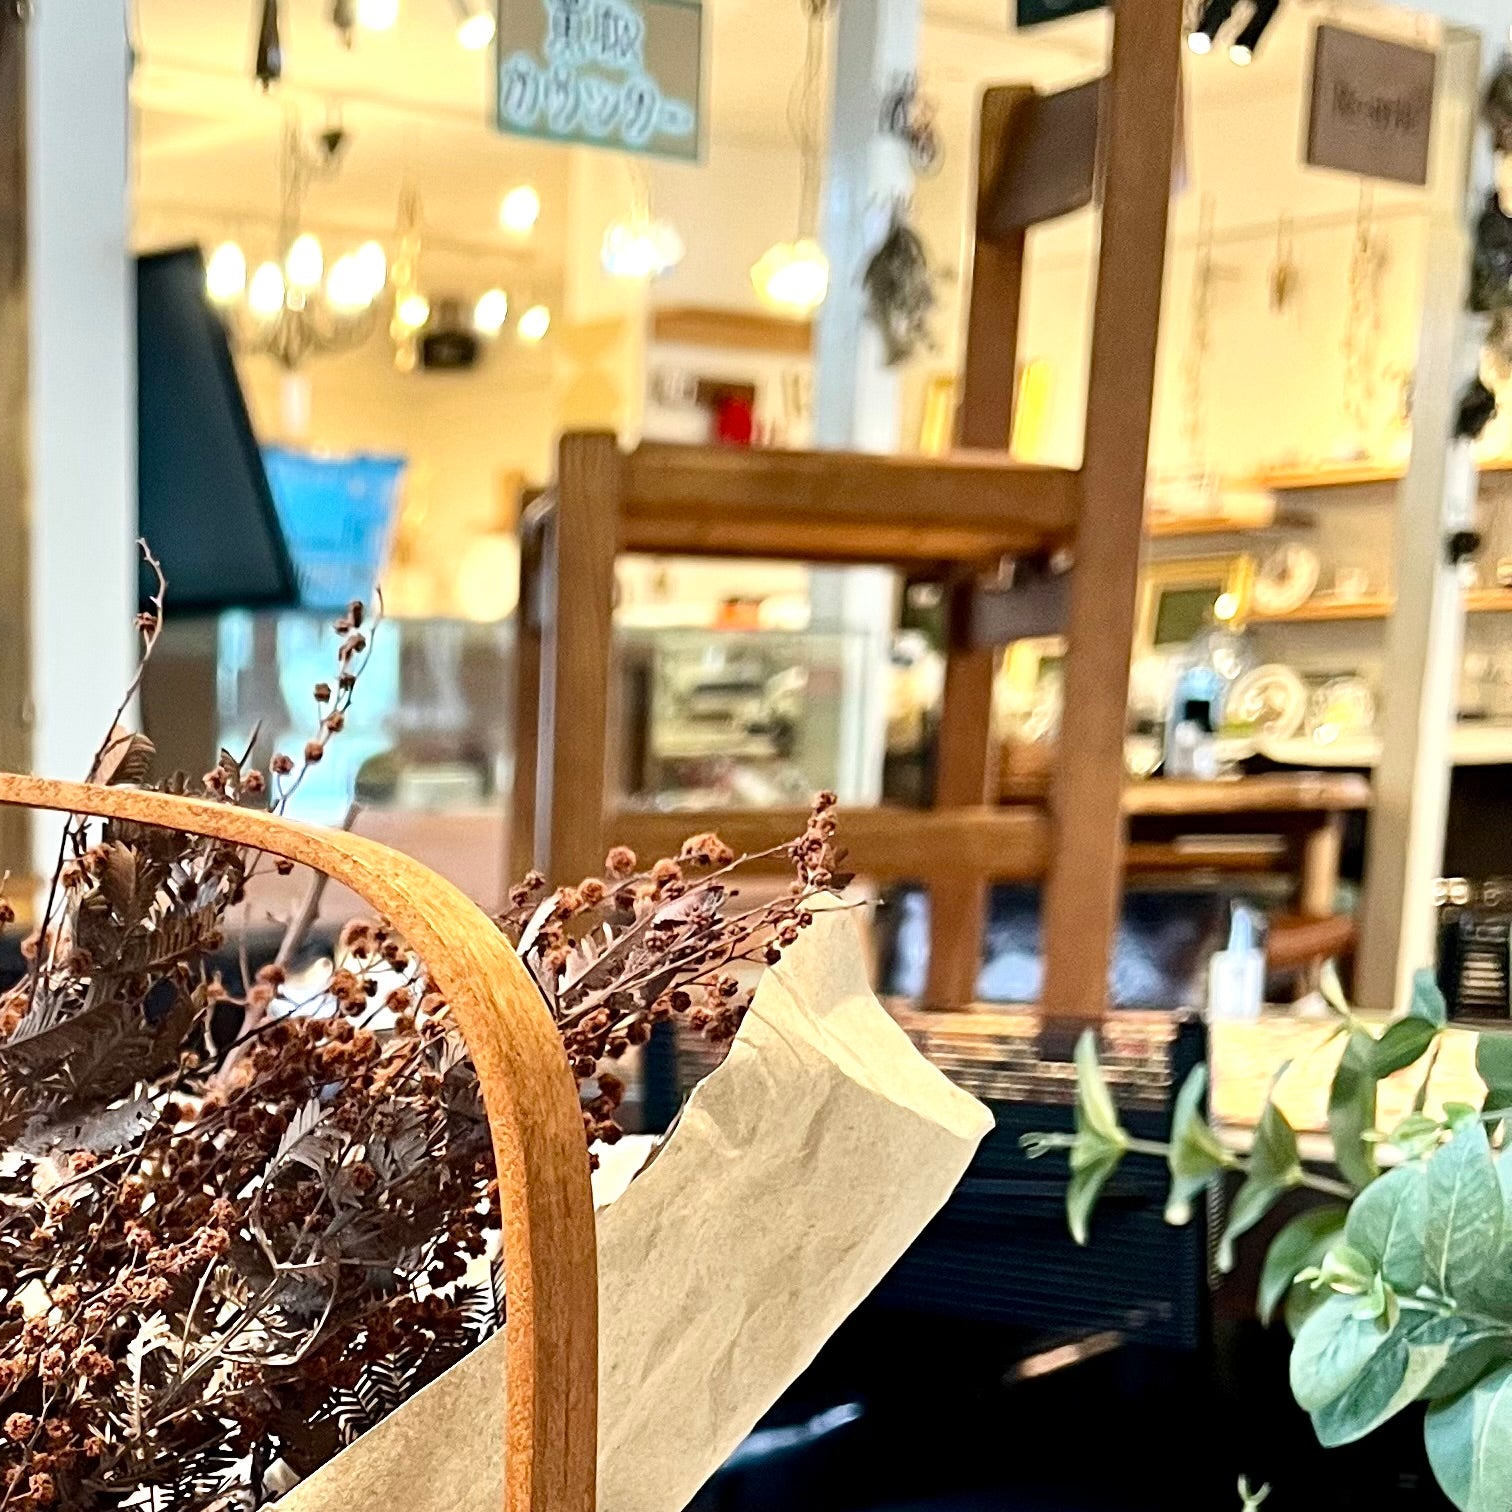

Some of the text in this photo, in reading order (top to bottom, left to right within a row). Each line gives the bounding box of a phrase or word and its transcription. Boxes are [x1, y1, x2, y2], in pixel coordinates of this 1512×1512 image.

[502, 54, 690, 142] カウンター
